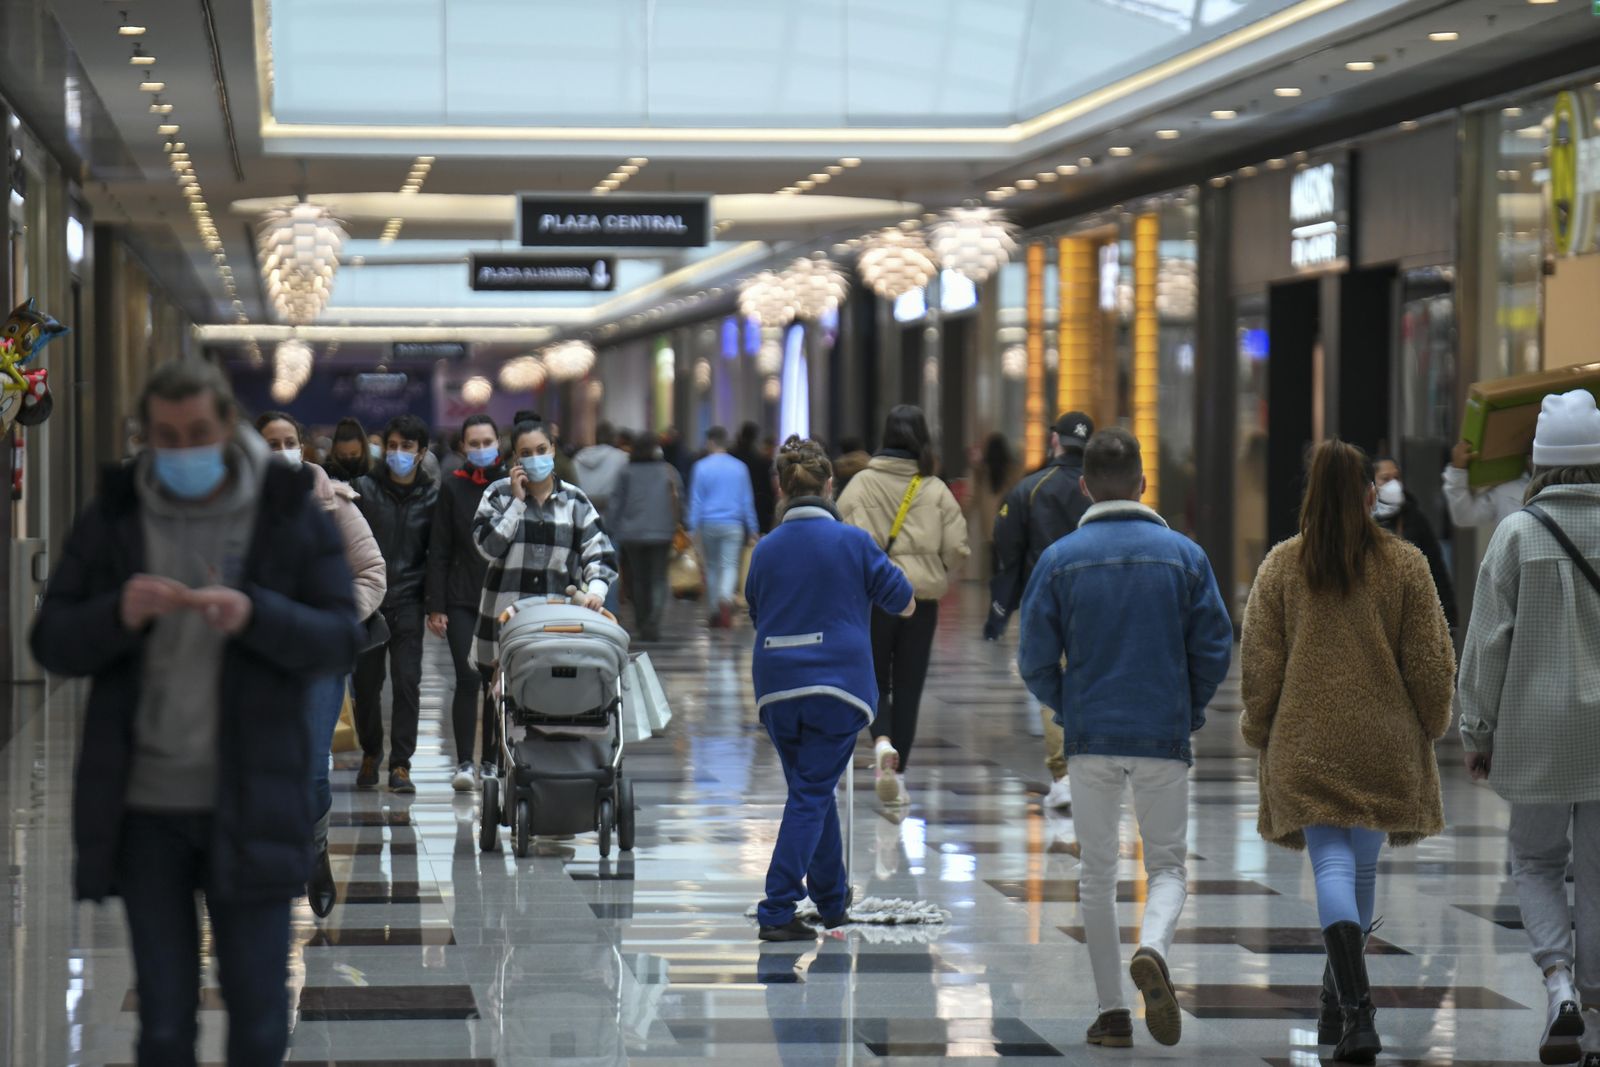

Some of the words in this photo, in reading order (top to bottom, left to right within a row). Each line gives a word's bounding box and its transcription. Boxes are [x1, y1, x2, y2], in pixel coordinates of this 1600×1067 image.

[540, 214, 600, 233] PLAZA
[602, 214, 688, 234] CENTRAL
[479, 266, 521, 282] PLAZA
